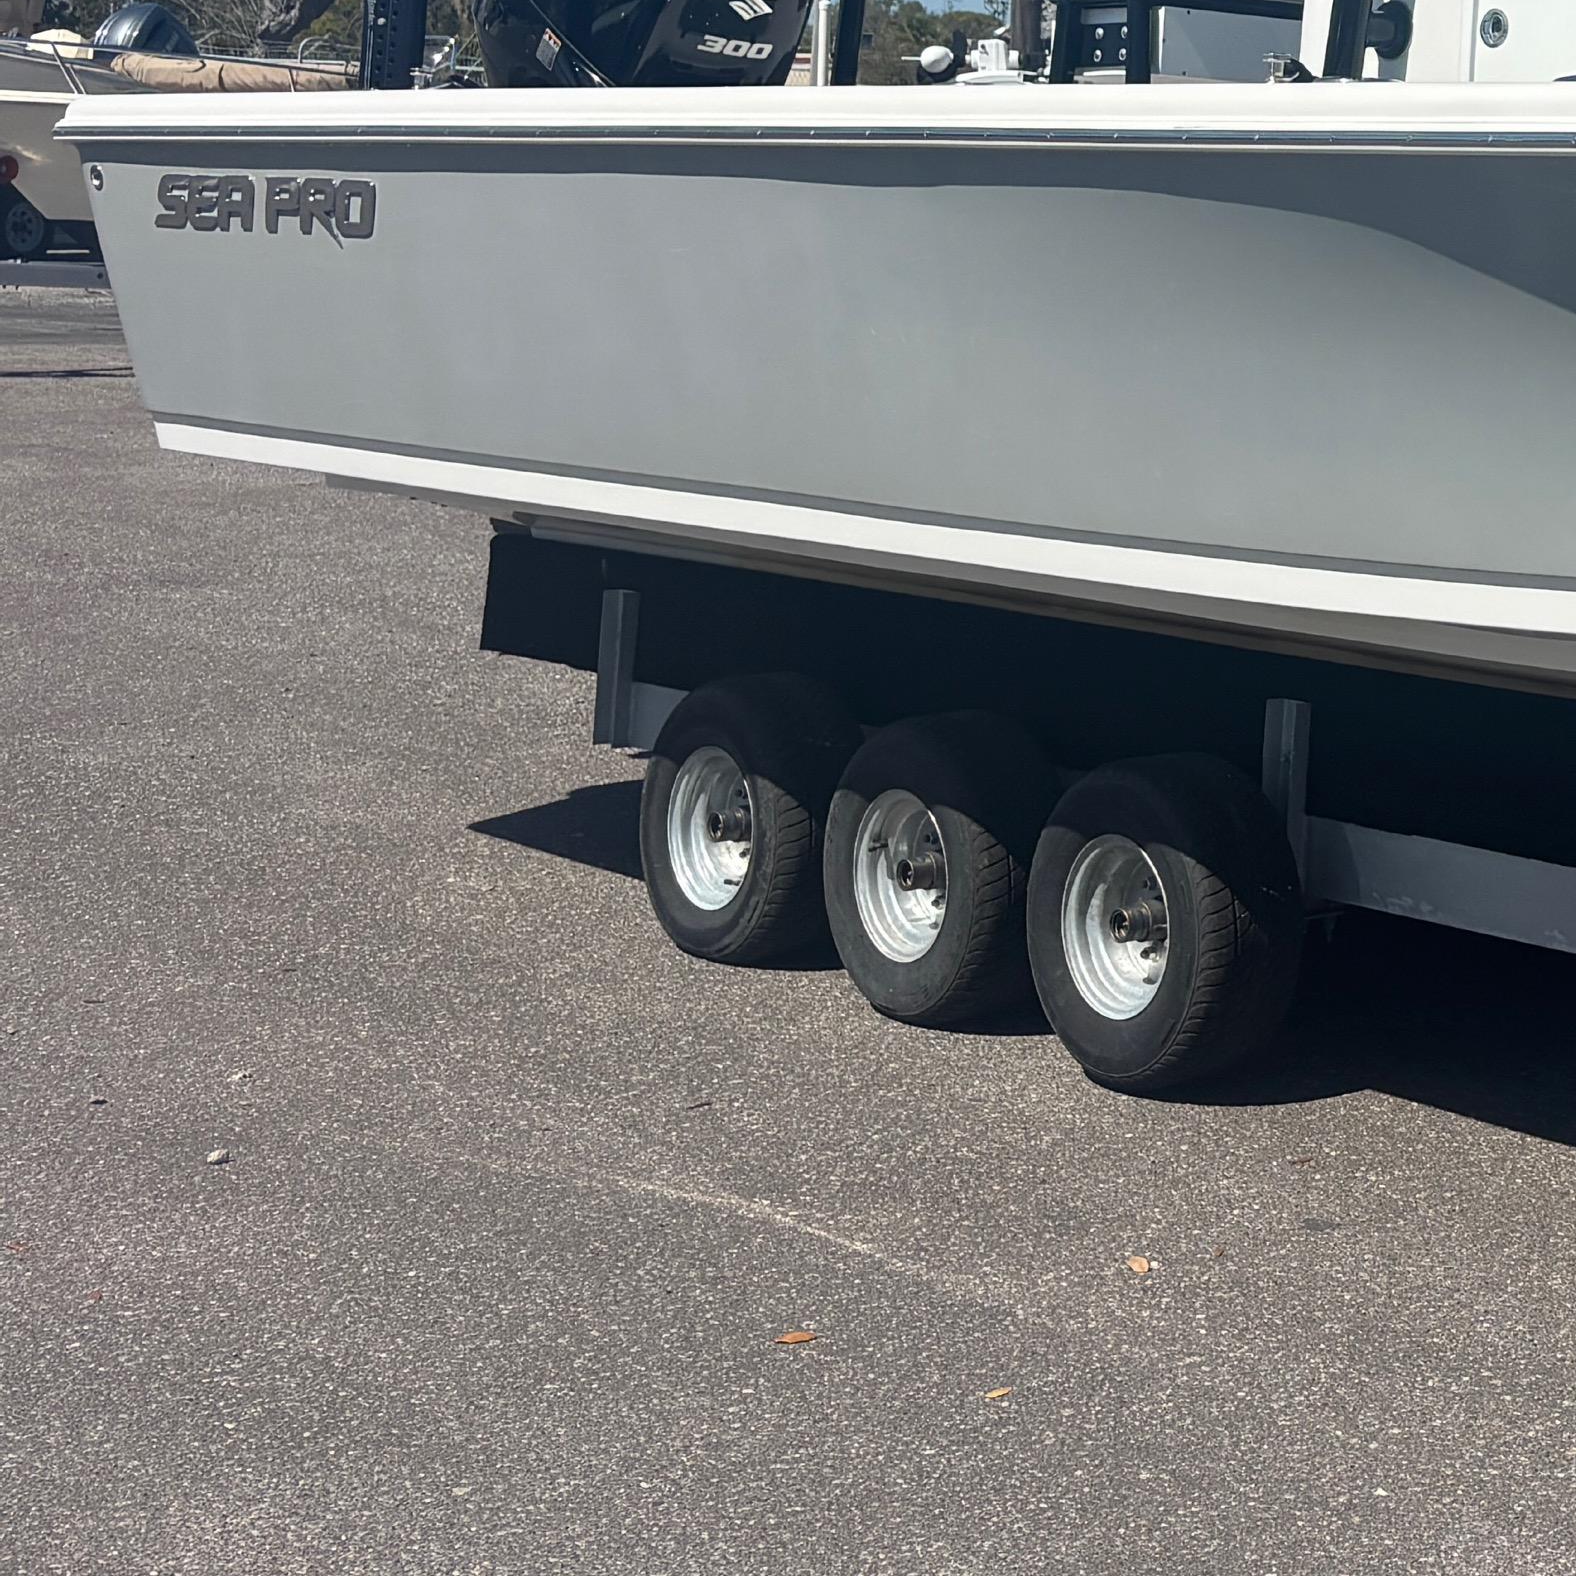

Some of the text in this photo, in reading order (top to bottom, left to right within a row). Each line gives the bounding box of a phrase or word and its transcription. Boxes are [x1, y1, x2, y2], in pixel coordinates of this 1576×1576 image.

[697, 34, 773, 59] 300
[154, 174, 377, 249] SEA PRO
